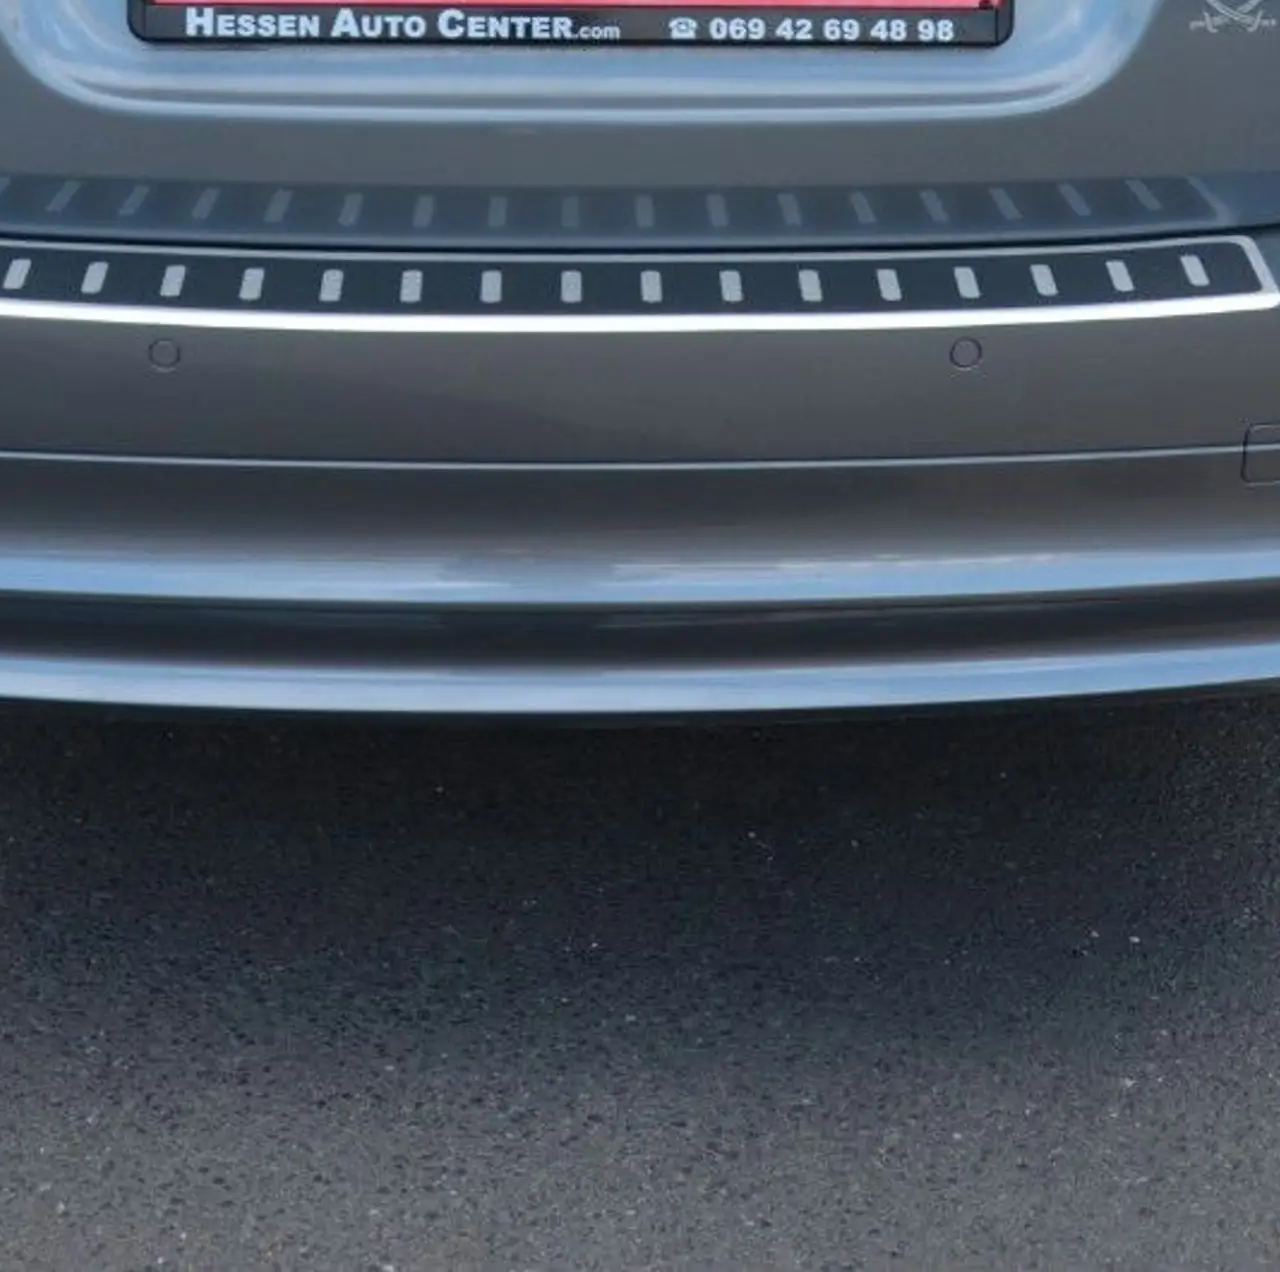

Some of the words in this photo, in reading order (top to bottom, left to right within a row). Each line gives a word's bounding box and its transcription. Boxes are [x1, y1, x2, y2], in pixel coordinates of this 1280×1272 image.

[330, 7, 427, 38] AUTO
[708, 17, 766, 41] 069
[775, 18, 814, 41] 42
[823, 18, 861, 42] 69
[870, 18, 908, 42] 48
[917, 19, 955, 43] 98
